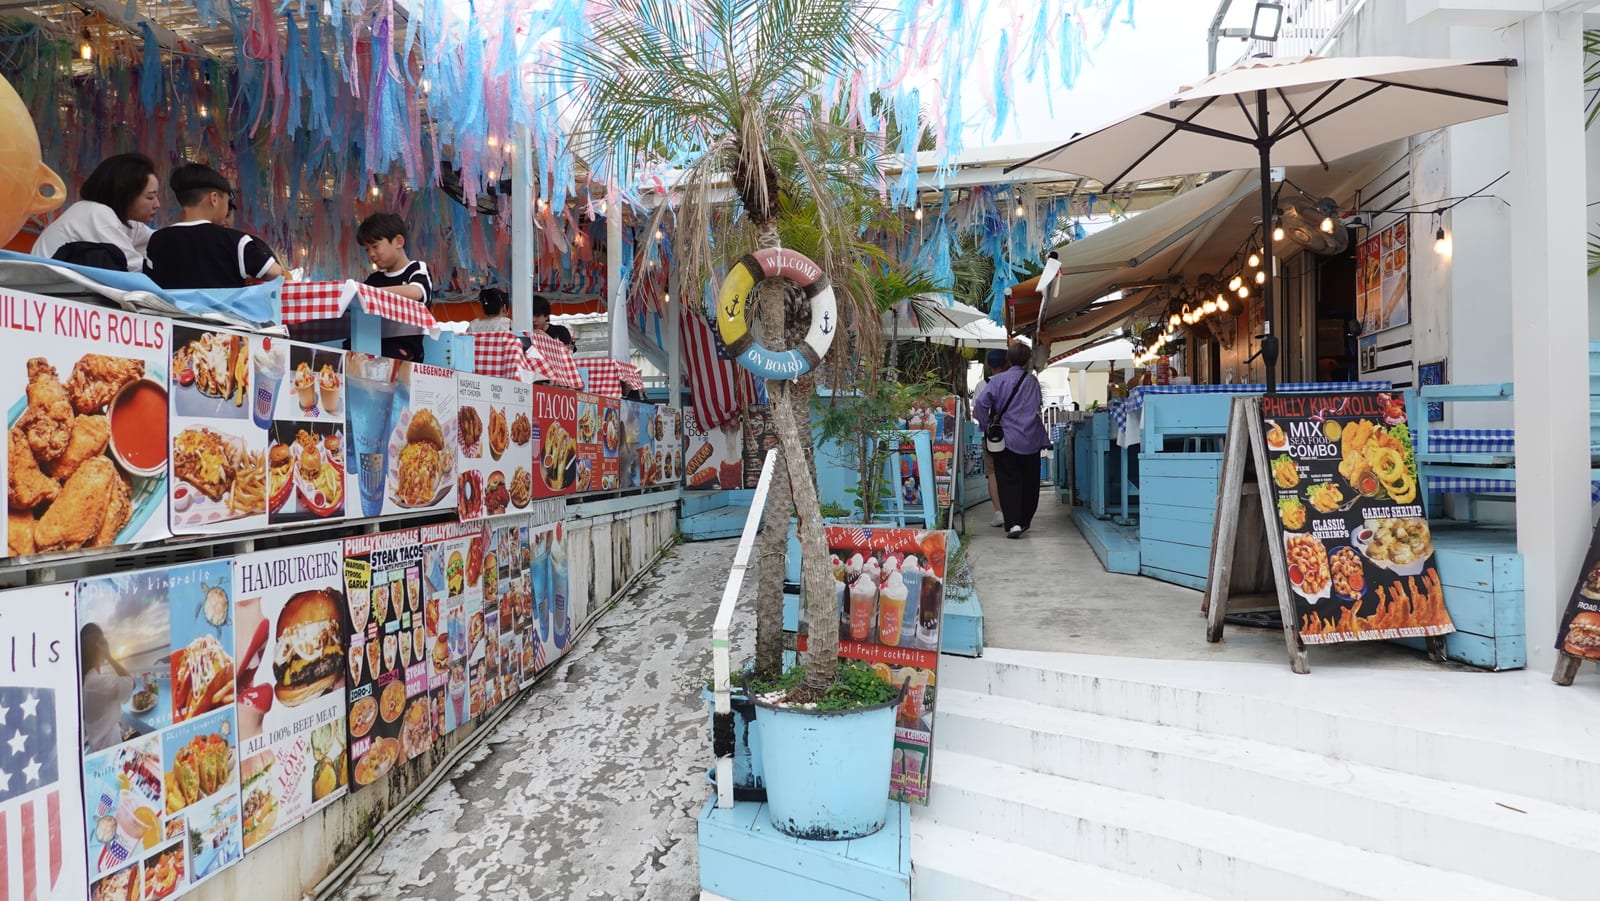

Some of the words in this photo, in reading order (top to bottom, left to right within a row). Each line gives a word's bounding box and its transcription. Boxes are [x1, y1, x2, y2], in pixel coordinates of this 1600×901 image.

[766, 254, 818, 281] WLCOME
[0, 294, 46, 332] ILLY
[54, 304, 101, 341] KING
[107, 313, 164, 349] ROLLS
[748, 349, 763, 365] ON
[765, 359, 802, 373] BOARD
[413, 364, 420, 373] A
[420, 365, 455, 378] LEGENDARY
[536, 391, 576, 420] TACOS
[1263, 397, 1305, 416] PHILLY
[1290, 421, 1323, 438] MIX
[1290, 437, 1306, 445] SEA
[1308, 435, 1332, 445] FOOD
[1288, 444, 1338, 457] COMBO
[1362, 507, 1391, 519] GARLIC
[1391, 505, 1422, 518] SHRIMP
[1312, 519, 1346, 531] CLASSIC
[399, 544, 424, 560] TACOS
[241, 550, 338, 593] HAMBURGERS
[348, 579, 368, 589] GARLIC
[856, 643, 880, 657] Fruit
[883, 648, 925, 662] cocktails
[247, 738, 266, 755] ALL
[269, 725, 292, 745] 100%
[293, 715, 315, 735] BEEF
[315, 705, 337, 727] MEAT
[352, 738, 370, 760] MAX
[278, 735, 306, 788] LOVE
